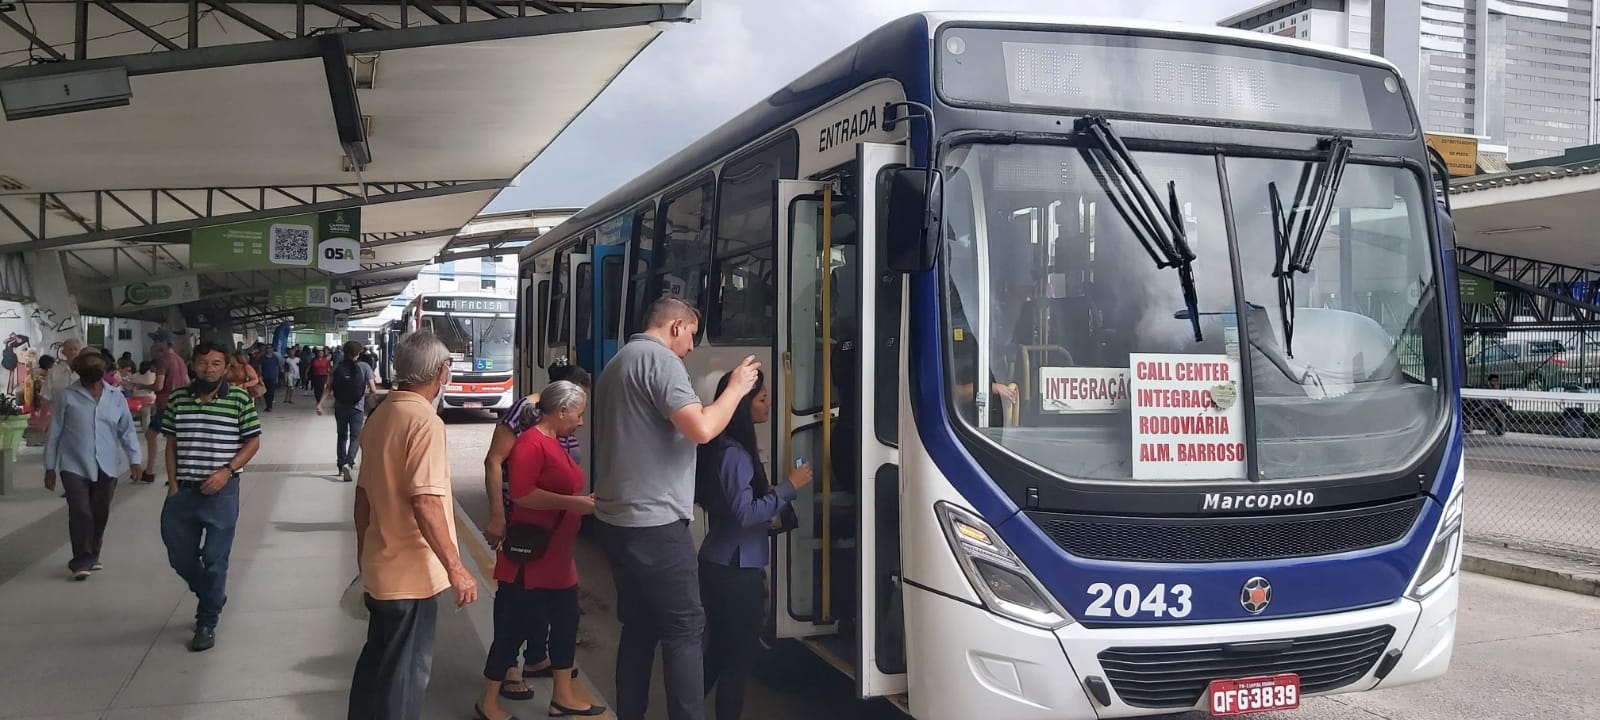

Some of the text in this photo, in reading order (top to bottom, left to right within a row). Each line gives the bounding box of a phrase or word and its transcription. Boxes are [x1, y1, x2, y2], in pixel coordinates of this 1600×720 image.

[1015, 47, 1280, 112] 092 RADIAL
[818, 105, 877, 153] ENTRADA
[325, 247, 354, 260] 05A
[461, 300, 502, 310] FACISA
[1137, 361, 1229, 381] CALL CENTER
[1046, 373, 1131, 406] INTEGRAÇÃ
[1137, 389, 1217, 411] INTEGRAÇ
[1139, 413, 1229, 435] RODOVIÁRIA
[1139, 443, 1245, 462] ALM. BARROSO
[1203, 490, 1314, 510] Marcopolo
[1084, 582, 1192, 618] 2043
